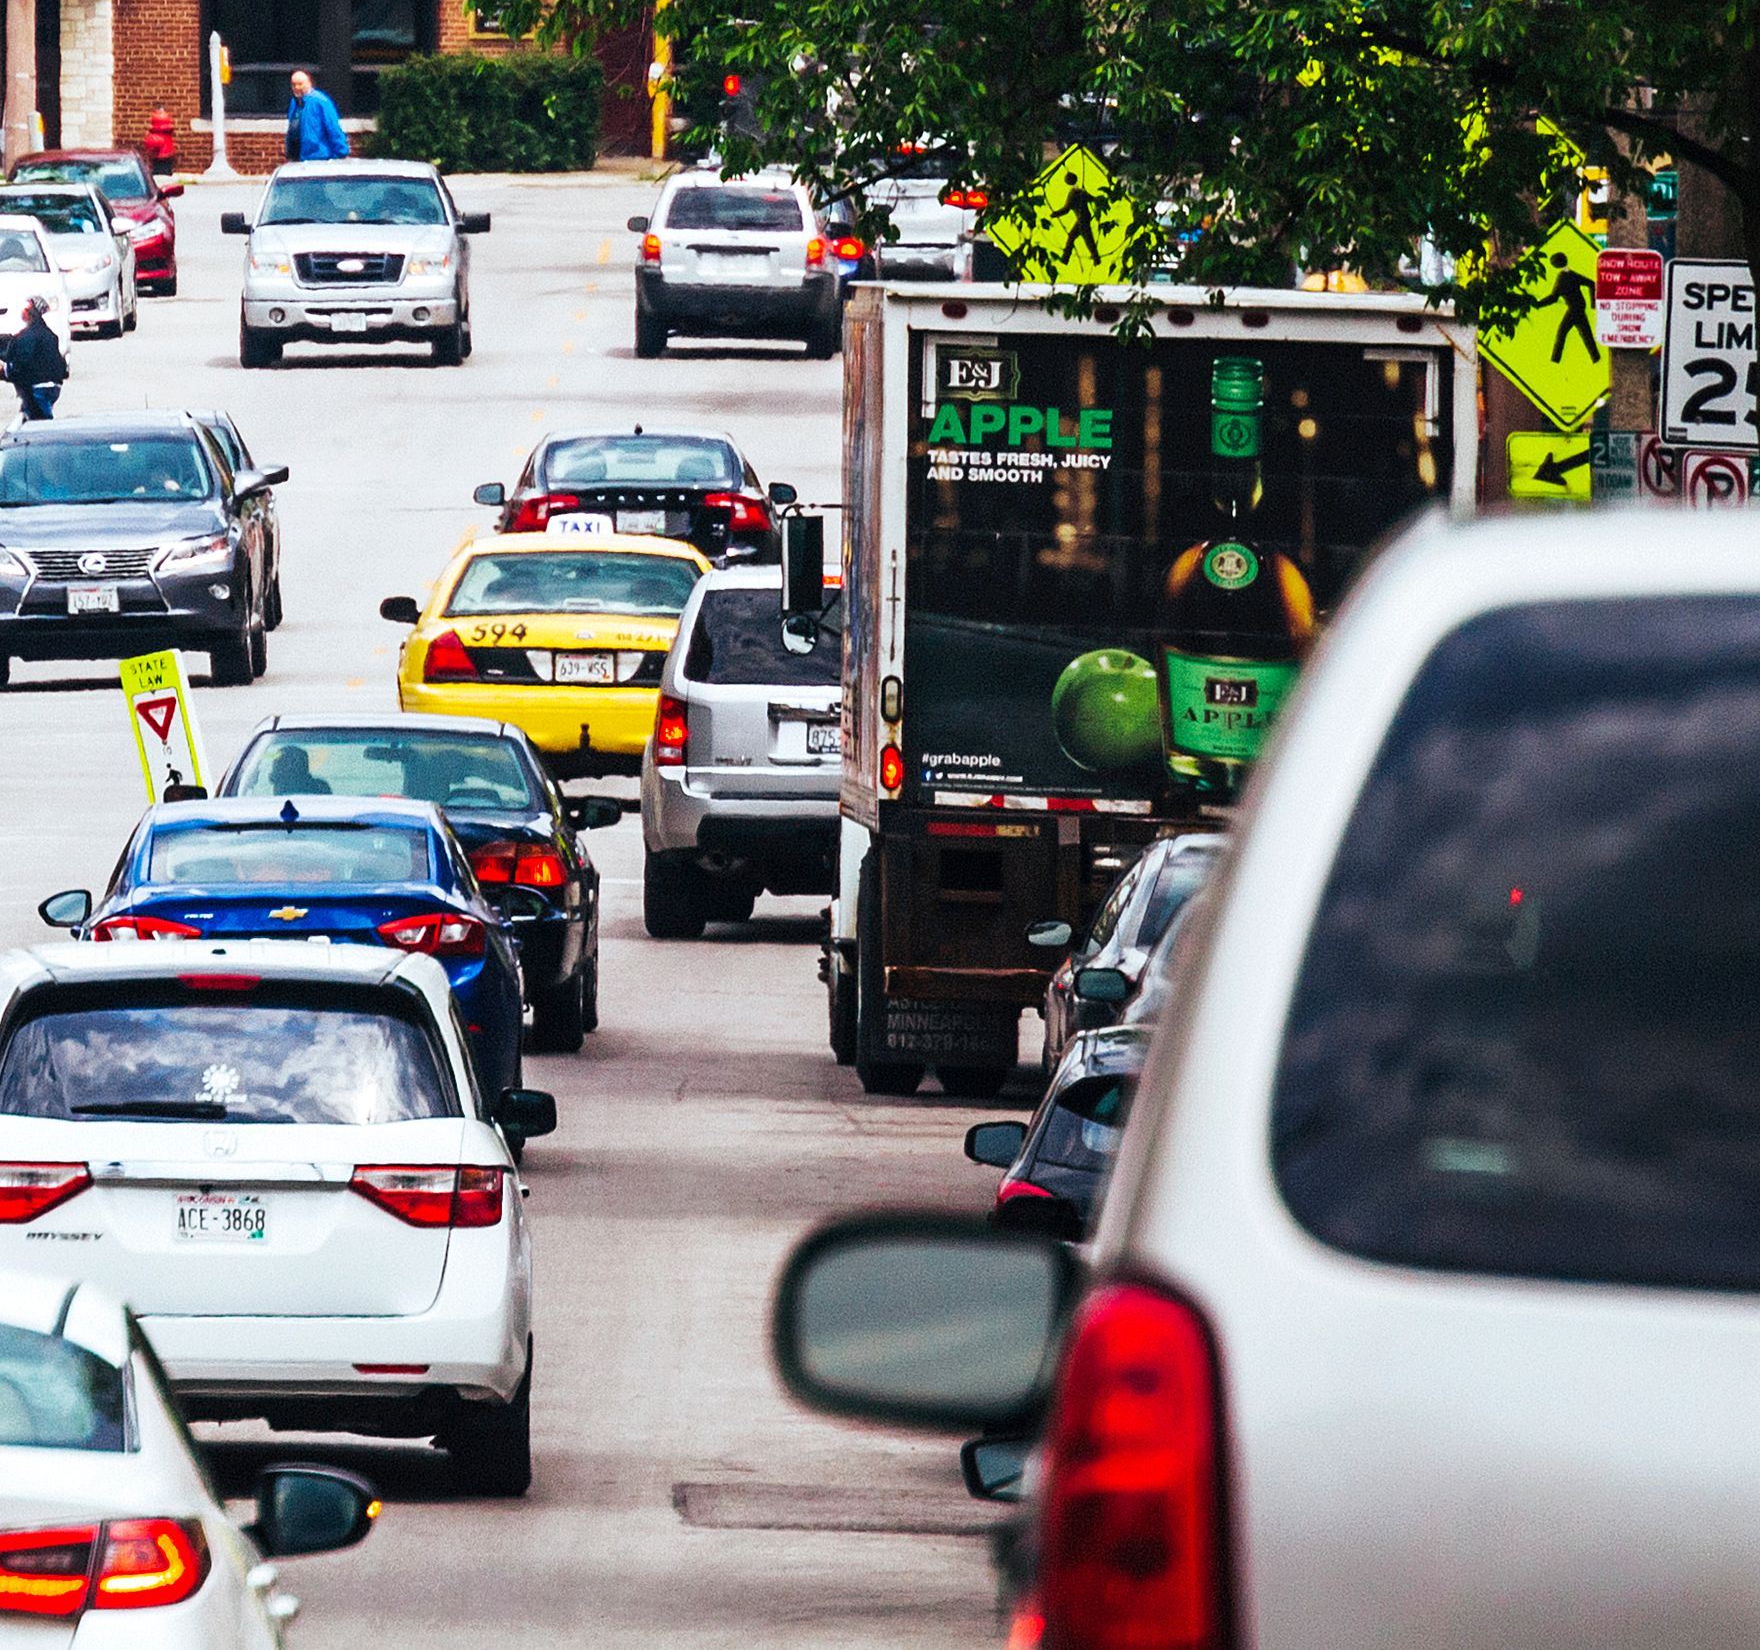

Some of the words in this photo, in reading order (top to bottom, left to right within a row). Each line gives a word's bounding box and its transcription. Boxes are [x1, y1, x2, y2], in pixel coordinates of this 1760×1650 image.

[1614, 285, 1644, 296] ZONE
[1694, 320, 1754, 351] LIM
[947, 359, 1003, 389] E&J
[927, 403, 1113, 448] APPLE
[927, 449, 992, 466] TASTES
[996, 452, 1058, 469] FRESH,
[1060, 453, 1112, 470] JUICY
[926, 465, 964, 481] AND
[967, 467, 1044, 484] SMOOTH
[560, 521, 601, 535] TAXI
[471, 623, 528, 644] 594
[130, 658, 168, 675] STATE
[138, 675, 163, 689] LAW
[922, 752, 1002, 767] #grabapple
[178, 1207, 266, 1231] ACE-3868
